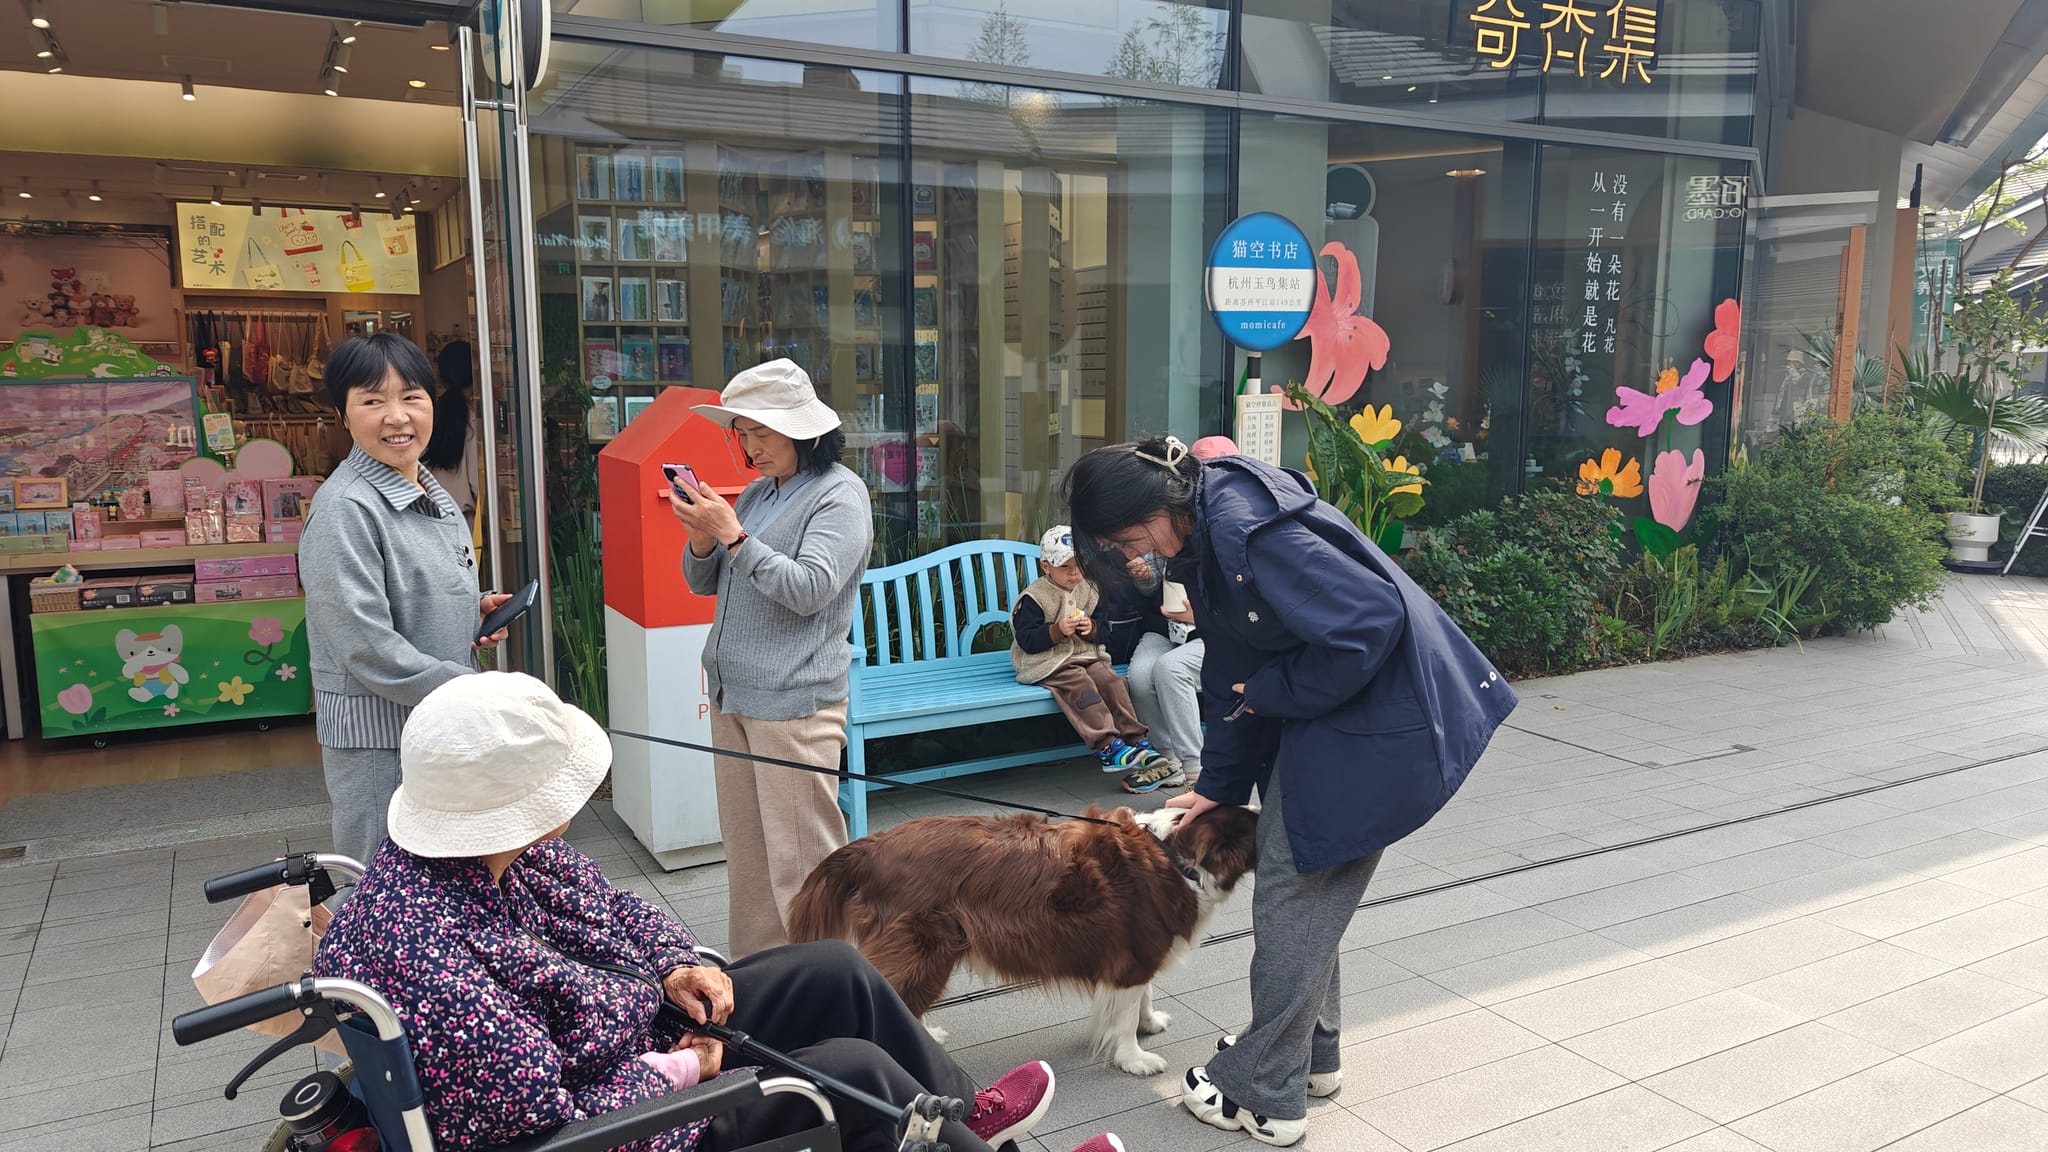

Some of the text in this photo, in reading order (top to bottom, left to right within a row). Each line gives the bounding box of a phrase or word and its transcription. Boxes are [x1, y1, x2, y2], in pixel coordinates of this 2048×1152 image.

[1232, 240, 1298, 260] 猫空书店
[1606, 173, 1628, 301] 没有一朵花
[1581, 171, 1606, 353] 从一开始就是花
[1228, 275, 1301, 290] 杭州玉鸟集站
[1240, 319, 1286, 329] momicafe
[1603, 318, 1617, 353] 凡花
